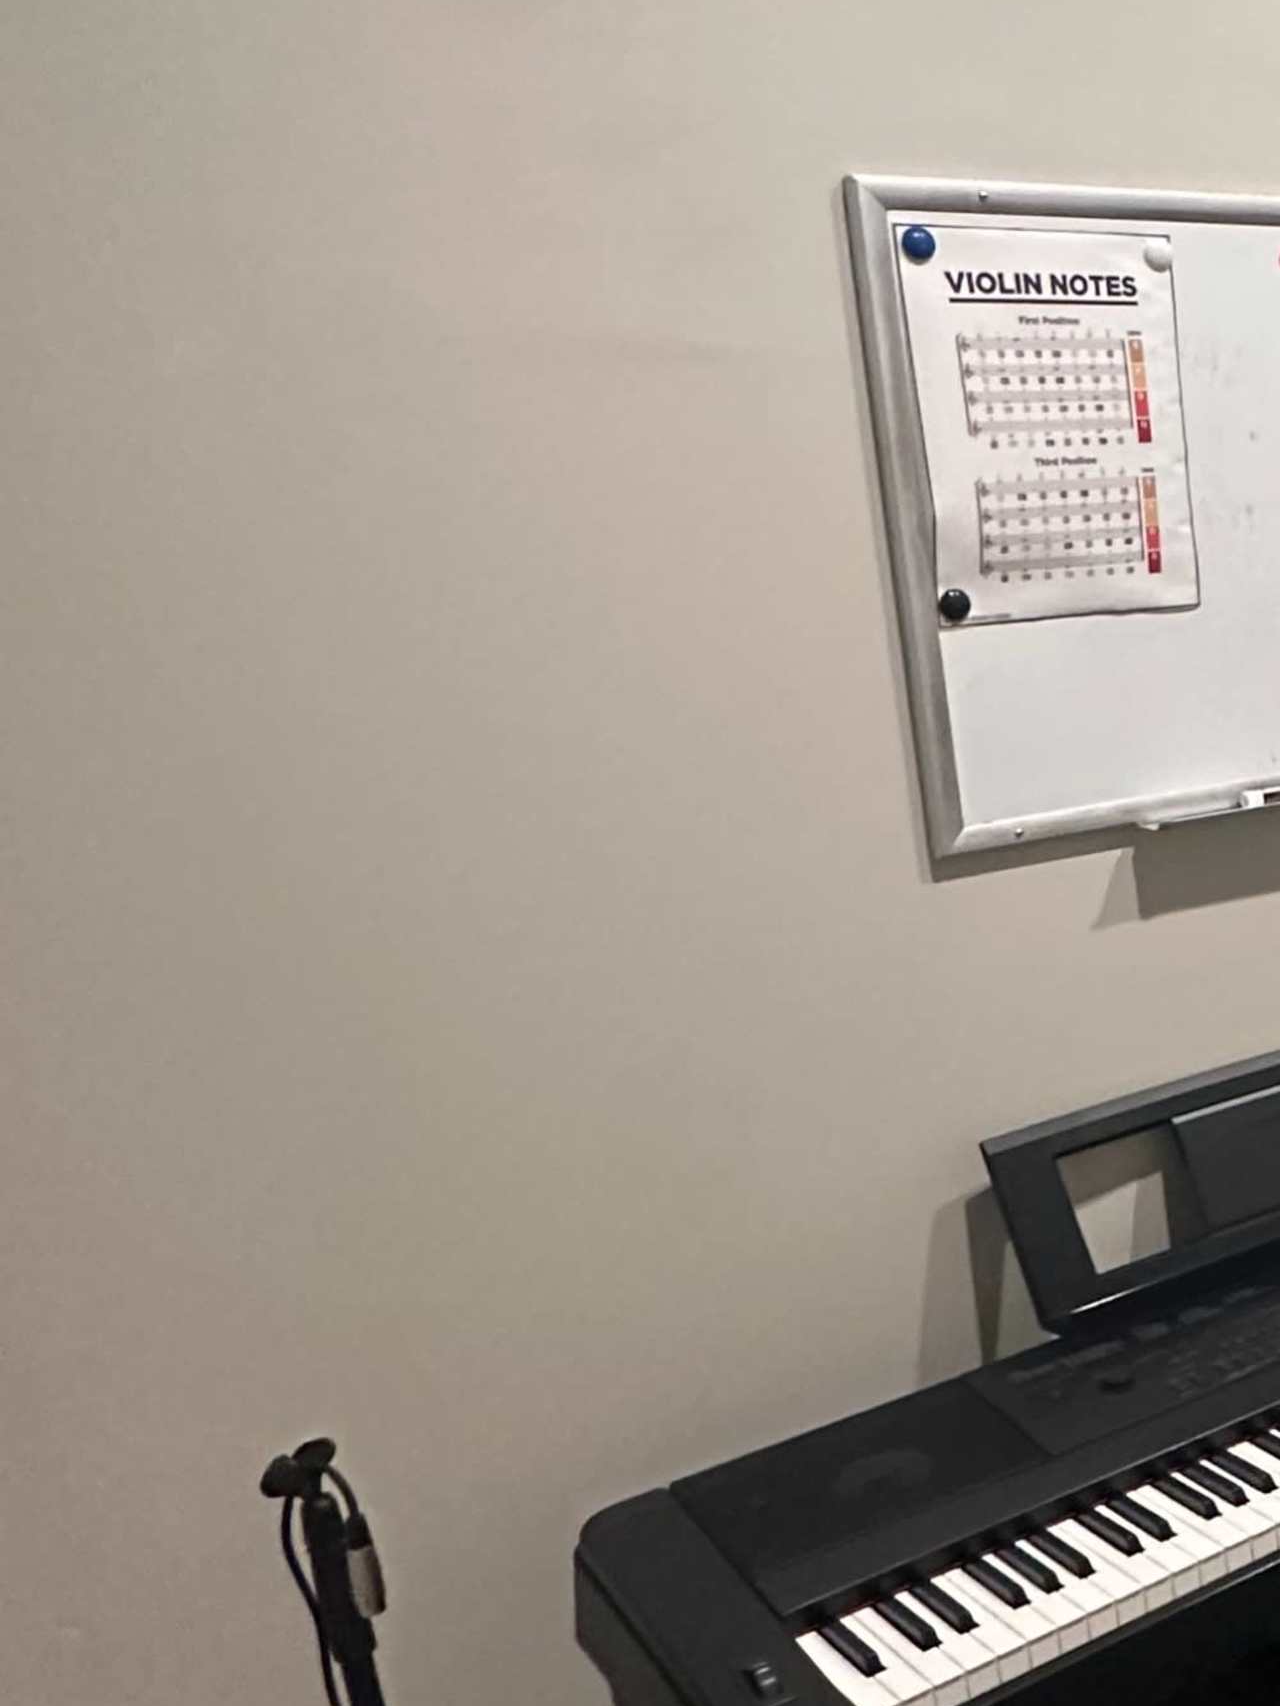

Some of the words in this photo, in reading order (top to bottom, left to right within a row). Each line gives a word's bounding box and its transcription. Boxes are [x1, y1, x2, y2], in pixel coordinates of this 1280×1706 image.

[944, 271, 1043, 295] VIOLIN
[1050, 273, 1138, 297] NOTES
[1018, 315, 1040, 325] First
[1034, 457, 1059, 466] Third
